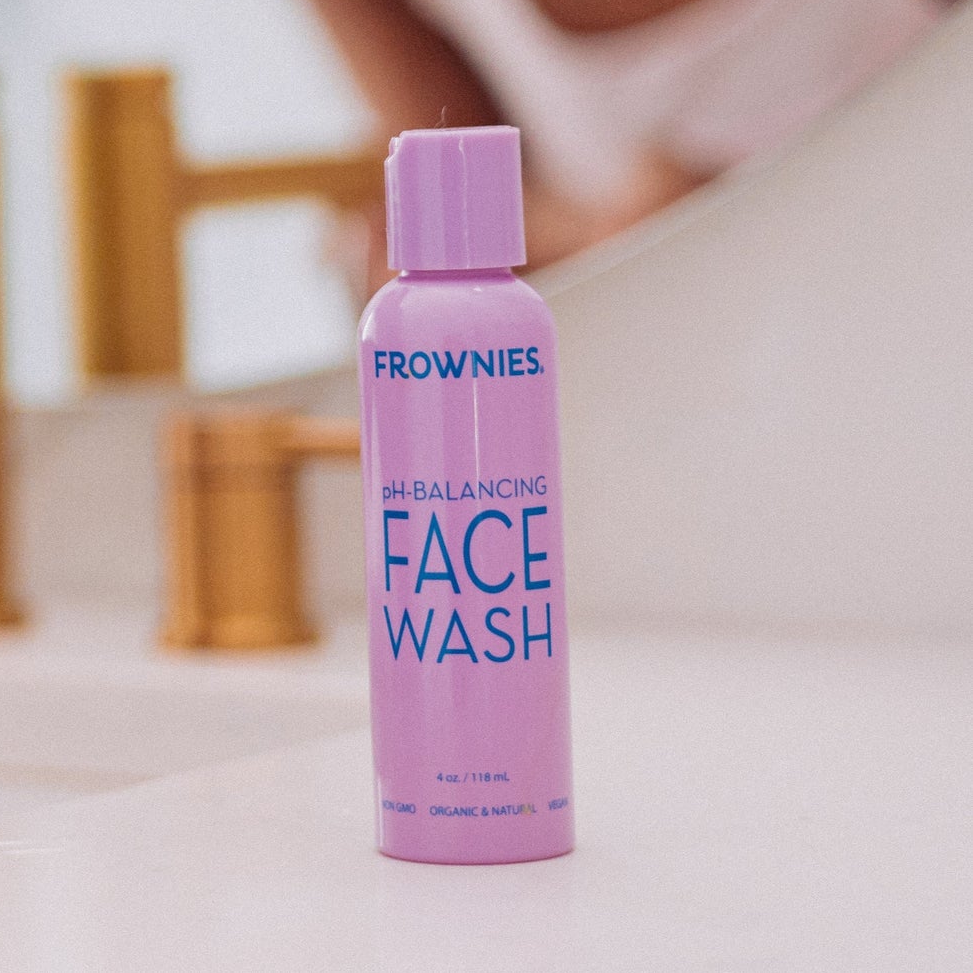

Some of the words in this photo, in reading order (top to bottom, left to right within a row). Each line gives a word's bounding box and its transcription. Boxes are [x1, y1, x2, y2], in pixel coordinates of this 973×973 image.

[382, 476, 547, 502] pH-BALANCING
[383, 506, 551, 594] FACE
[383, 603, 552, 663] WASH
[436, 773, 443, 782] 4
[446, 774, 461, 782] oz.
[471, 772, 491, 782] 118
[396, 803, 416, 814] GMO
[429, 806, 478, 817] ORGANIC
[481, 806, 489, 817] &
